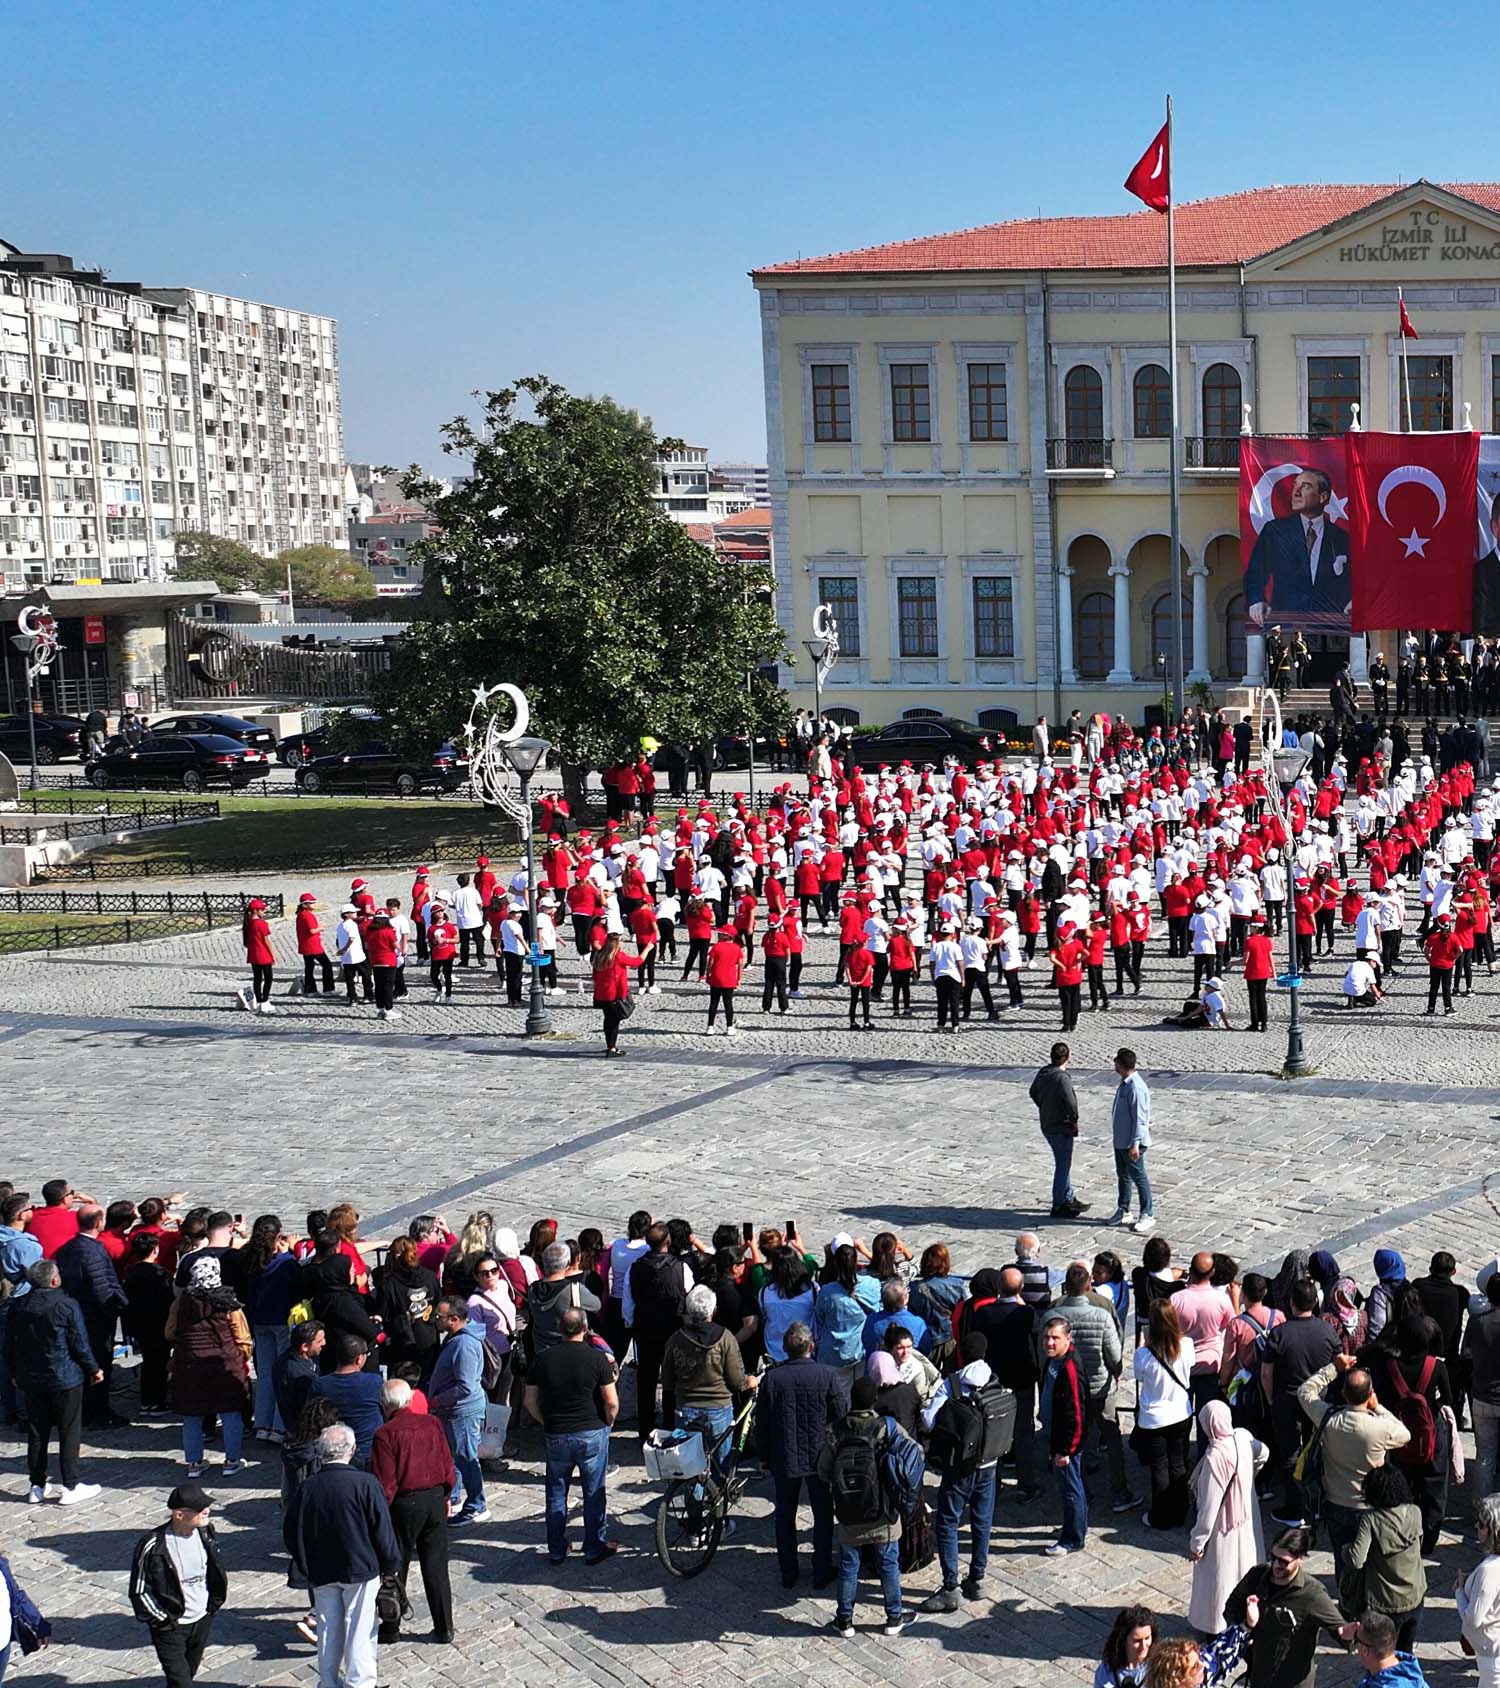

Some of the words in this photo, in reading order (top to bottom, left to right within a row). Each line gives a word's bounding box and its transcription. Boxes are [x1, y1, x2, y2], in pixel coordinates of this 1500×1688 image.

[1409, 211, 1422, 225] T
[1426, 211, 1440, 225] C
[1382, 226, 1433, 243] İZMİR
[1445, 225, 1467, 243] İLİ
[1339, 244, 1430, 262] HÜKÜMET
